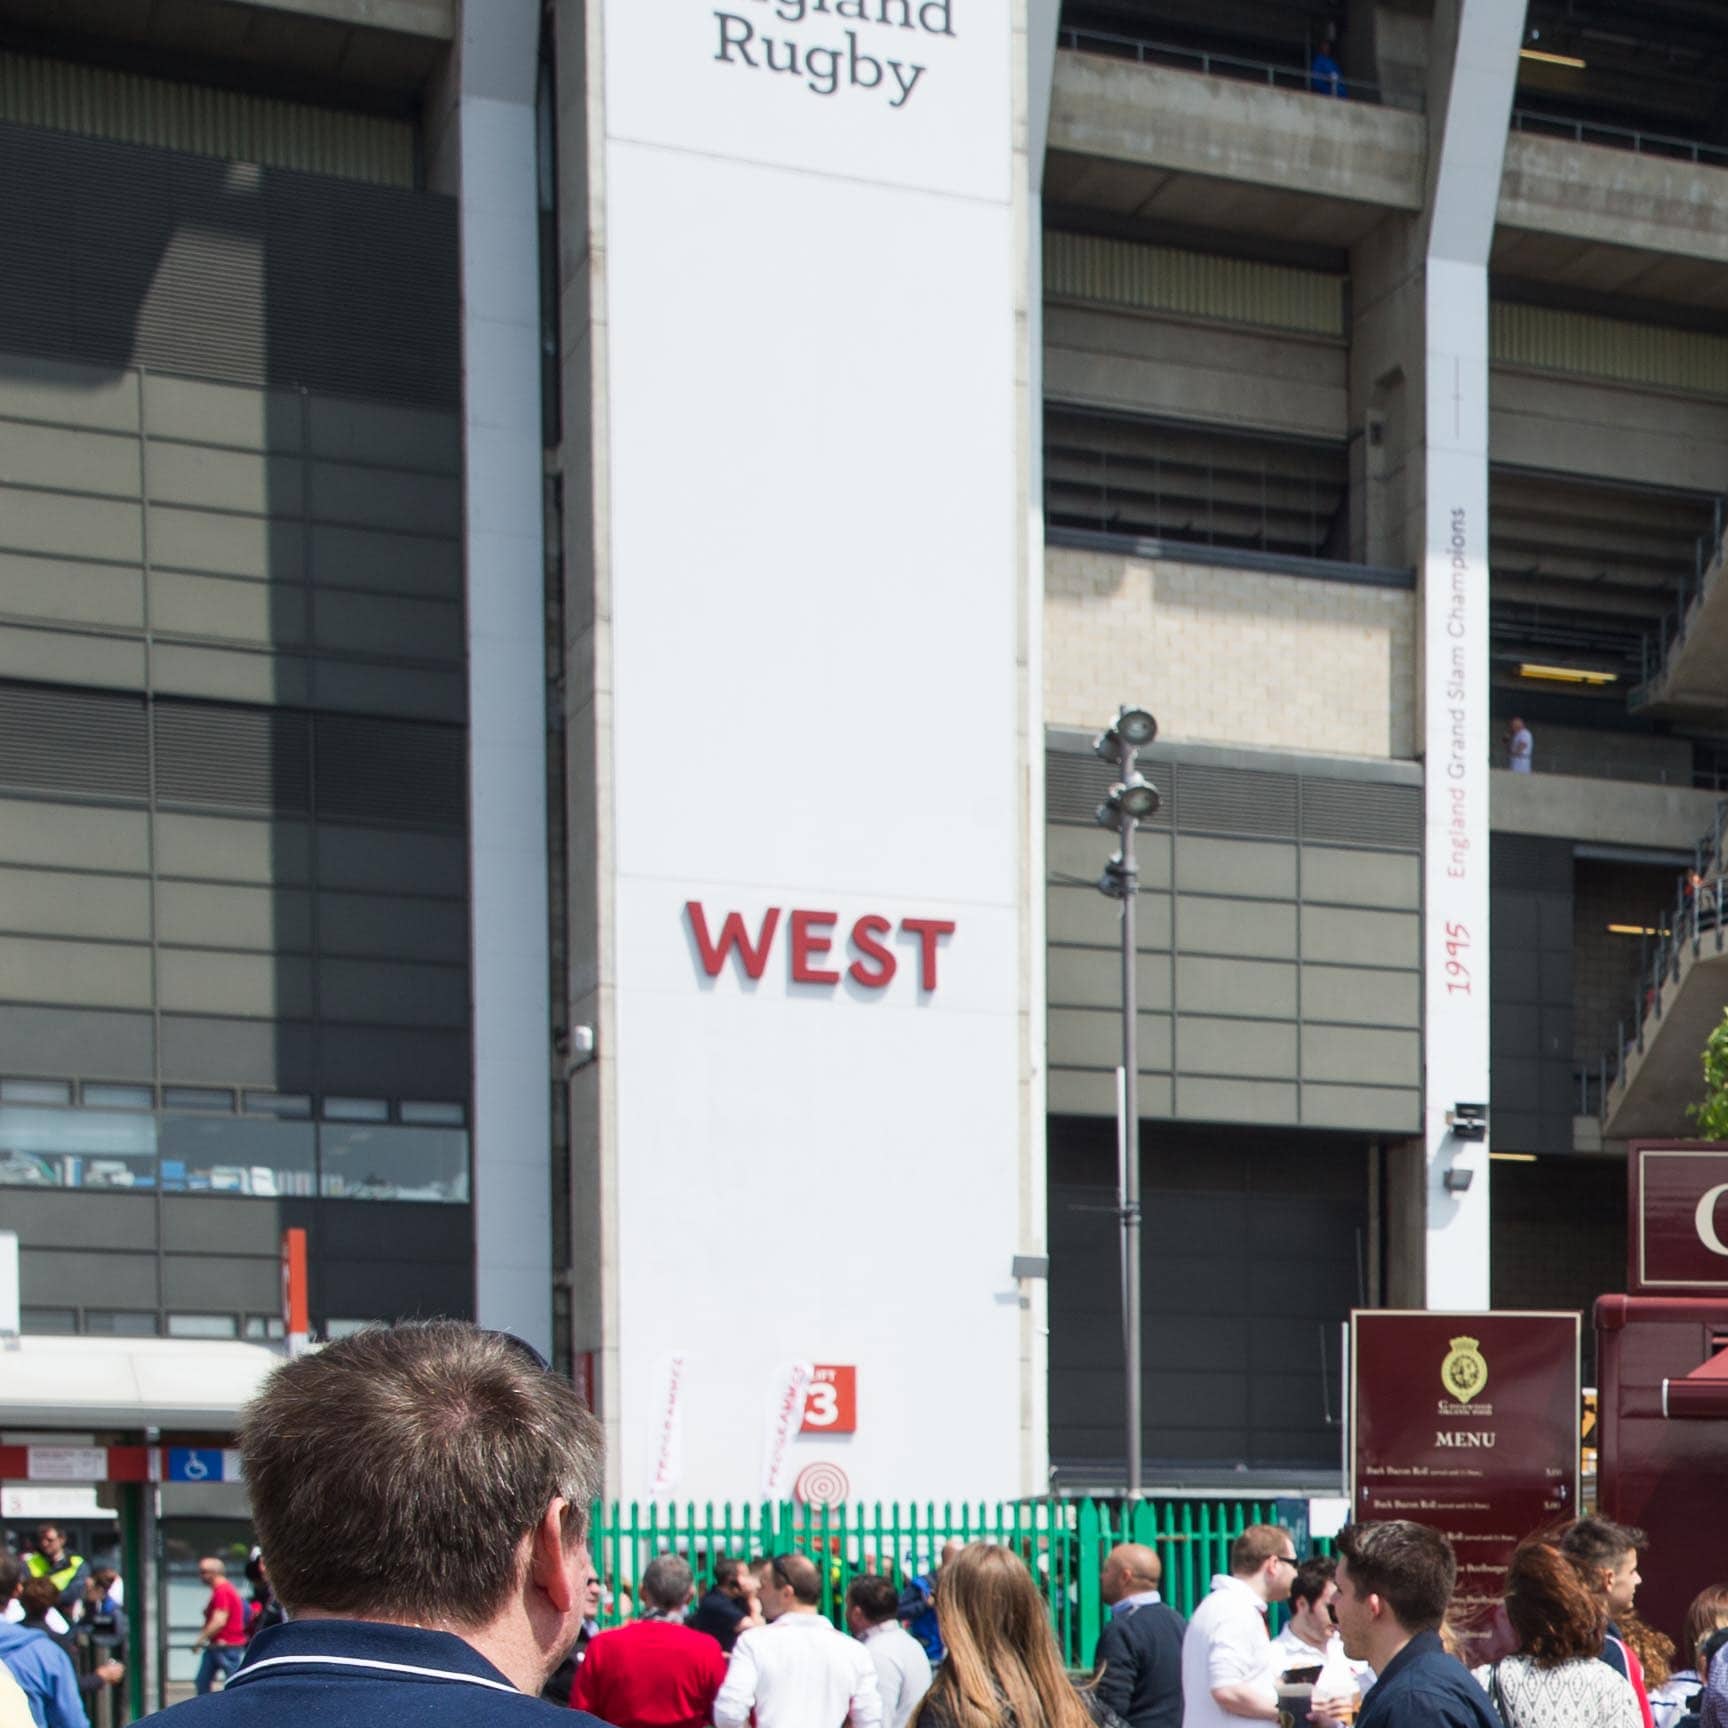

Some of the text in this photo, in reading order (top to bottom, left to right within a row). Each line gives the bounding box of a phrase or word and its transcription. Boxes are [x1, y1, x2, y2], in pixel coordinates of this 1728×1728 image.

[713, 11, 927, 108] Rugby
[1445, 506, 1472, 996] 1995 England Grand Slam Champions
[685, 900, 956, 994] WEST
[805, 1382, 840, 1427] 3
[1435, 1431, 1496, 1448] MENU
